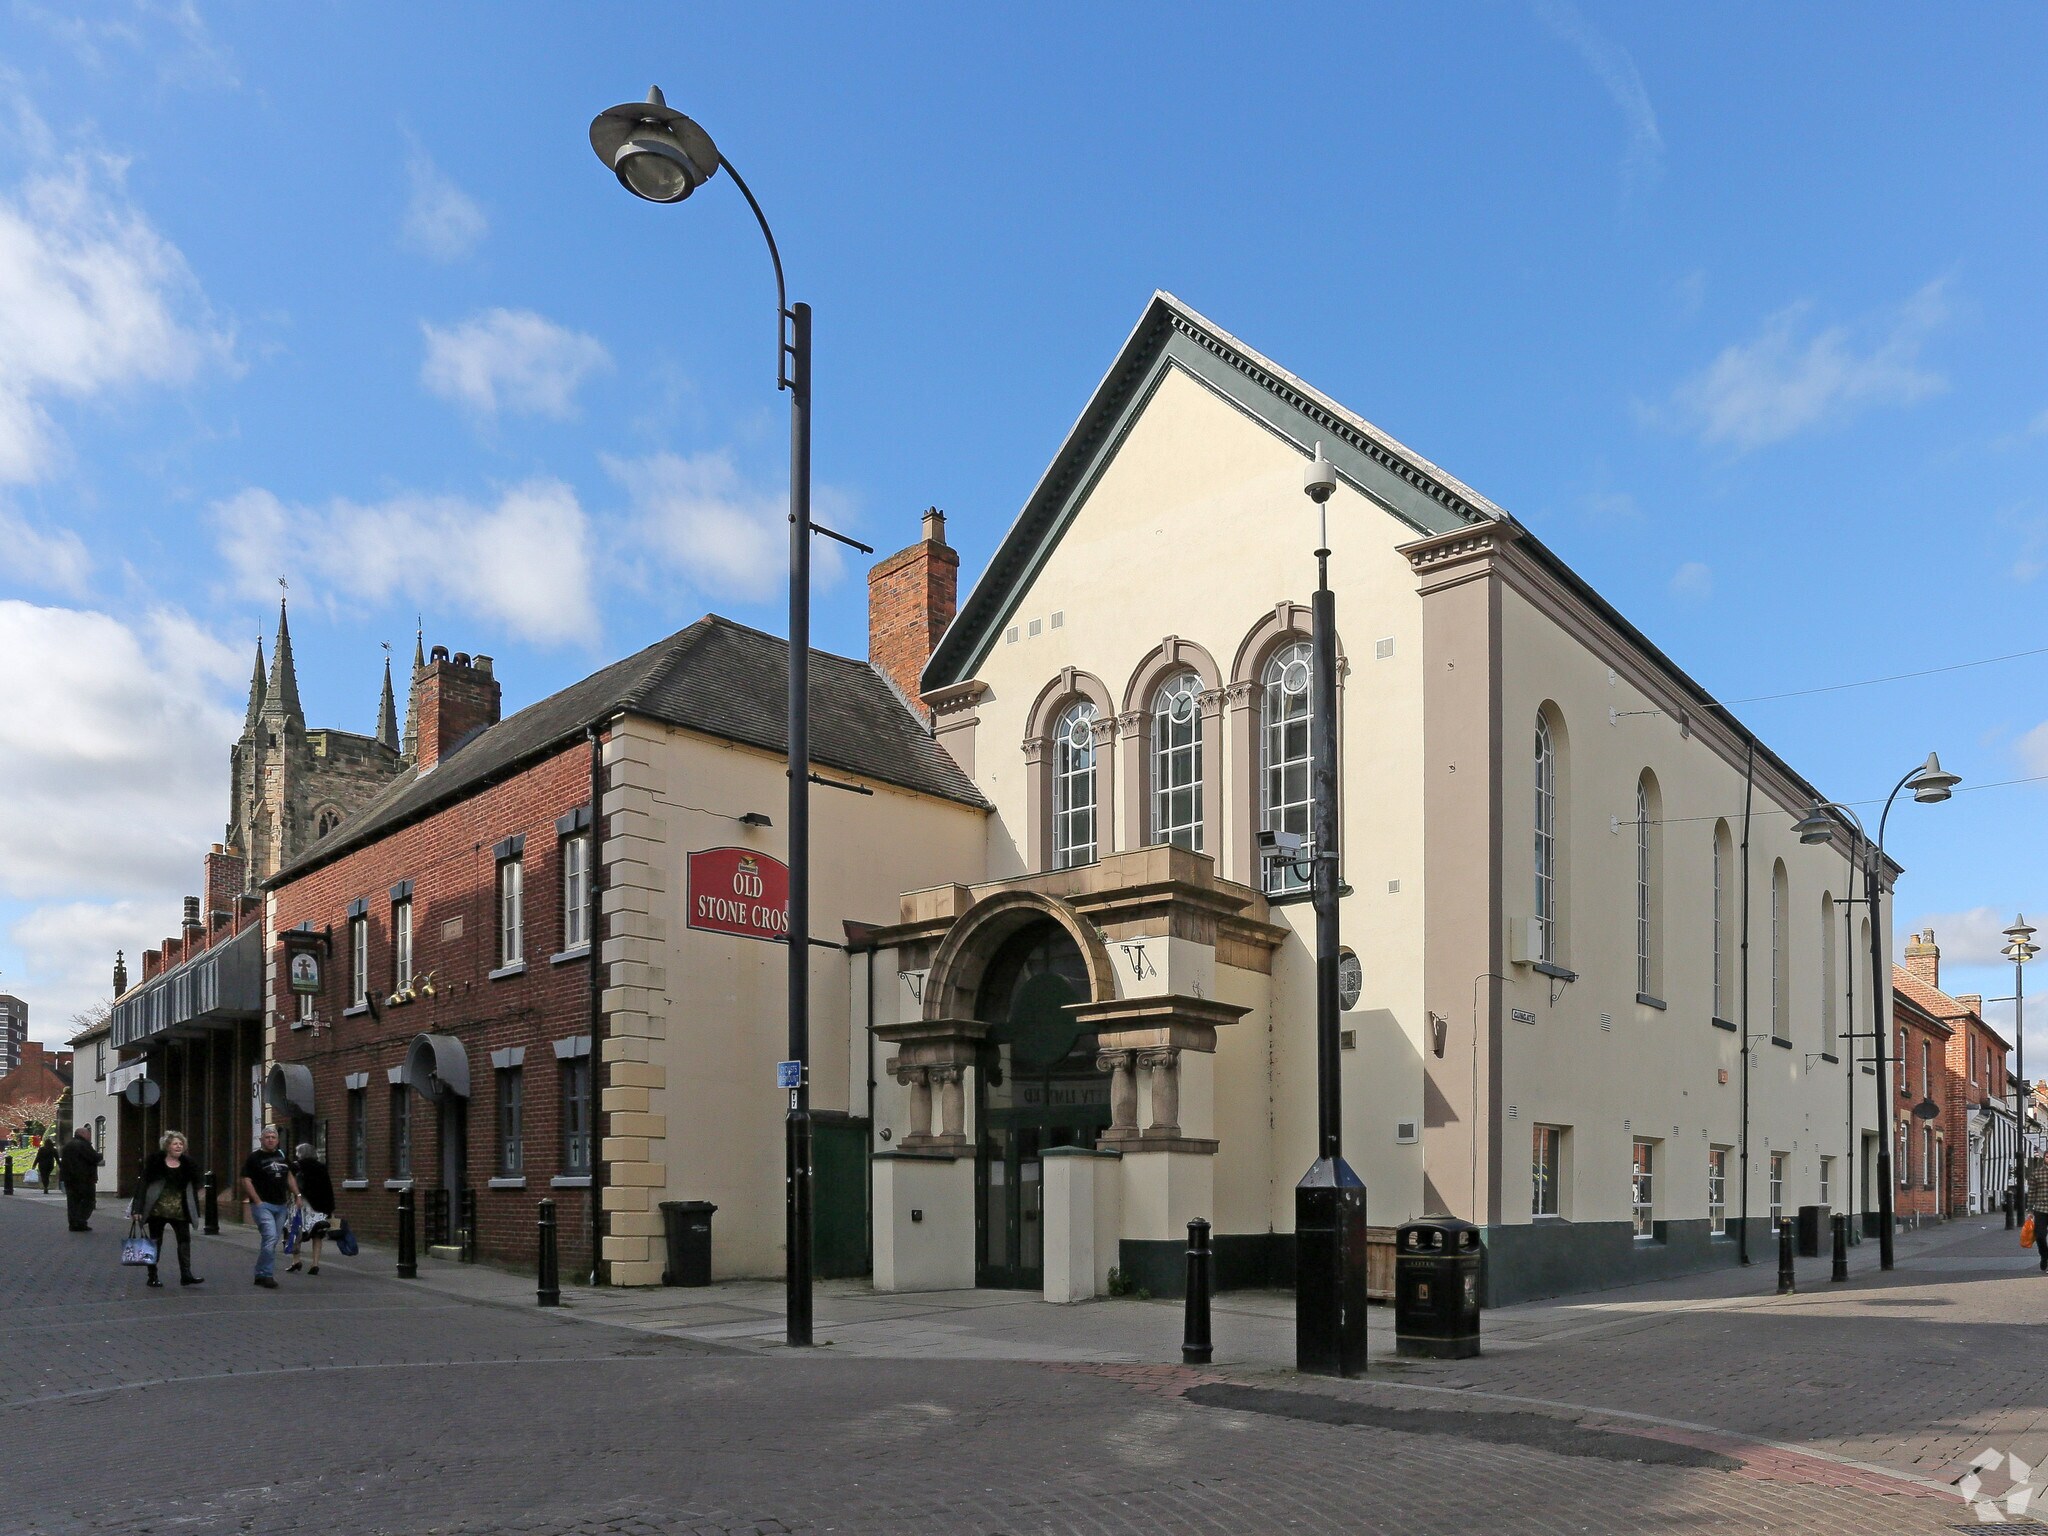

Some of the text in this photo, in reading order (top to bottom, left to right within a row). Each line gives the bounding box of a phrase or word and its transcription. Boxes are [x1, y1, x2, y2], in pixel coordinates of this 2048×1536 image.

[733, 872, 763, 898] OLD
[698, 894, 789, 932] STONE CROS
